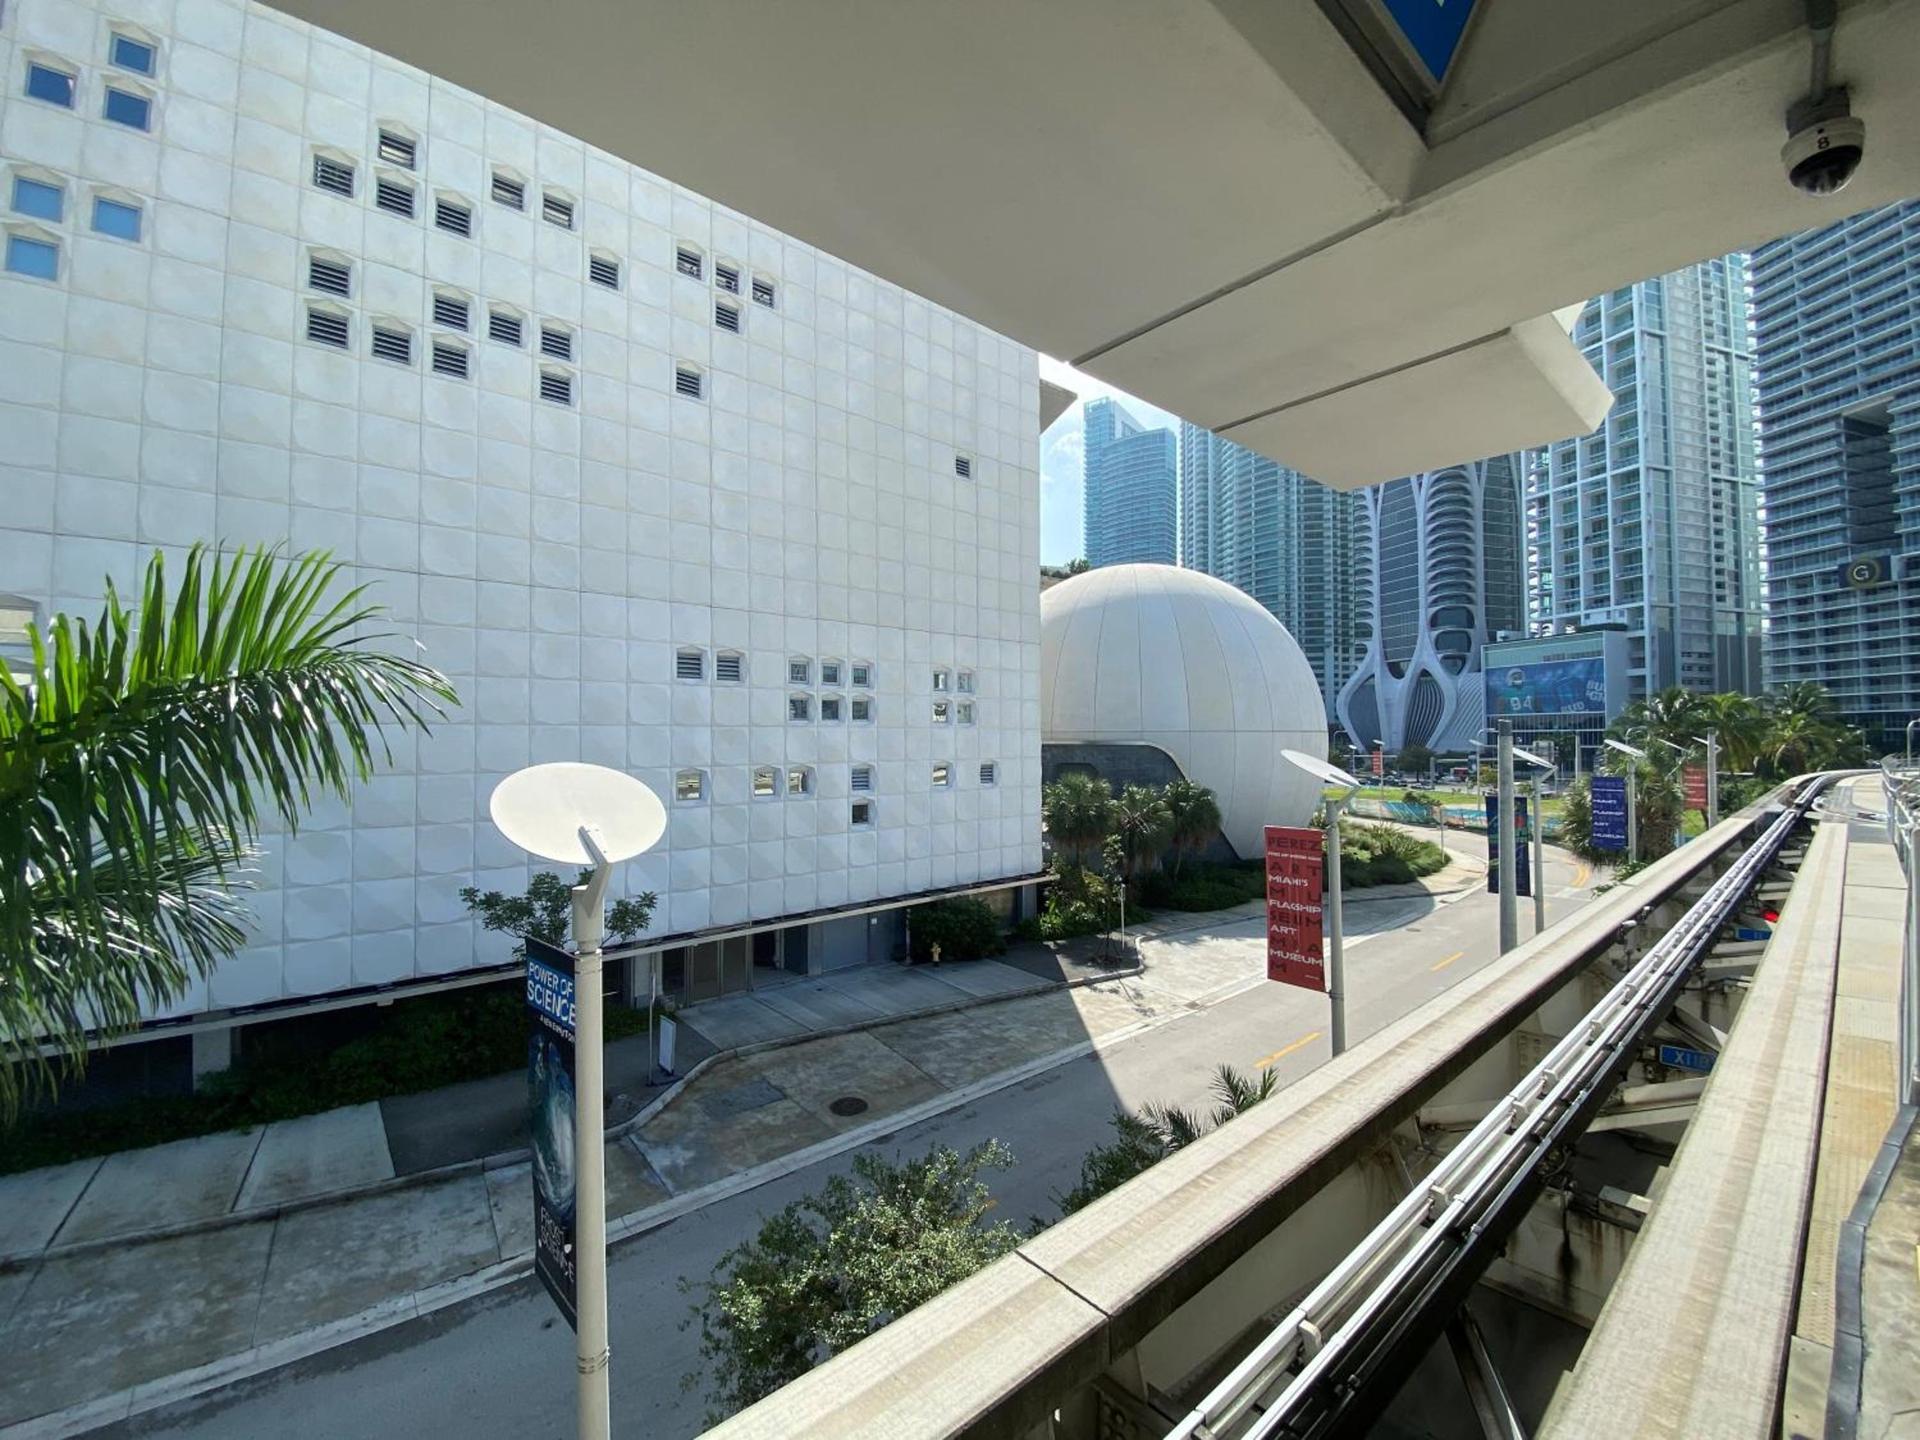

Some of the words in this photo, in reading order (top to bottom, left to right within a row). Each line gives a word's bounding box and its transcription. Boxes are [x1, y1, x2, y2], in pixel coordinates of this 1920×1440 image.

[1817, 137, 1830, 149] 8
[1853, 565, 1869, 581] G
[1268, 874, 1309, 888] MIAMI'S
[1269, 899, 1322, 914] FLAGSHIP
[1270, 924, 1299, 936] ART
[1269, 948, 1323, 968] MUSEUM
[528, 962, 559, 991] POWER
[560, 979, 573, 998] OF
[527, 980, 576, 1026] SCIENCE
